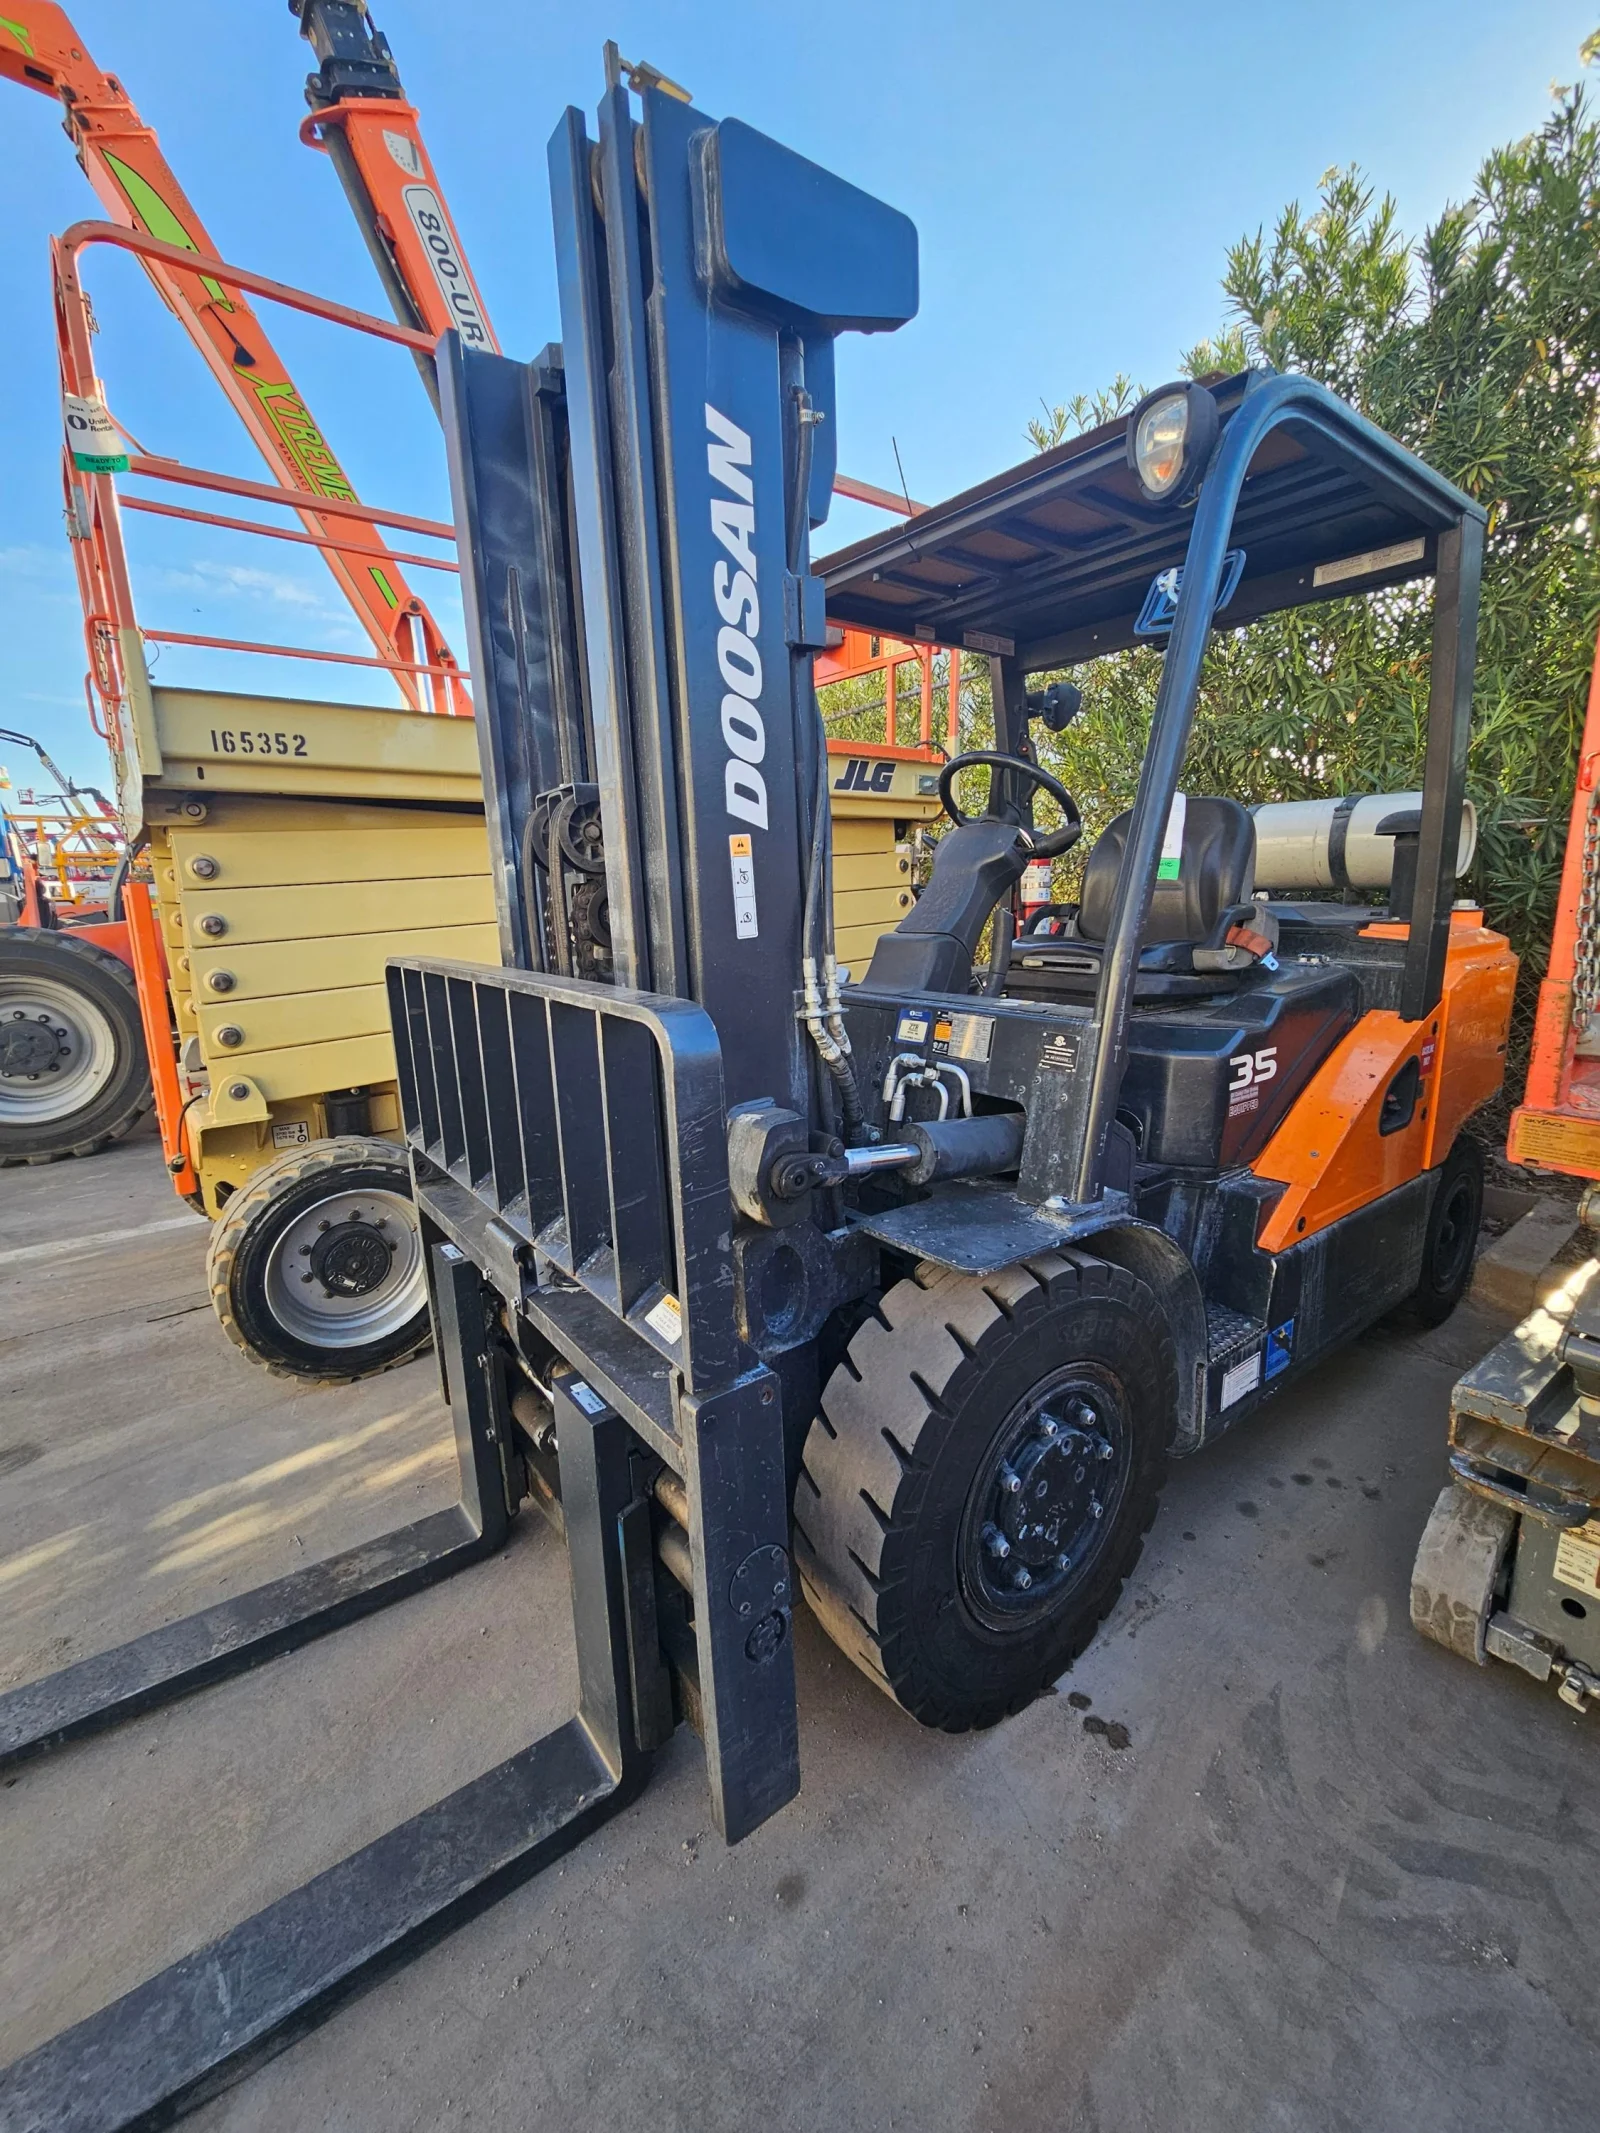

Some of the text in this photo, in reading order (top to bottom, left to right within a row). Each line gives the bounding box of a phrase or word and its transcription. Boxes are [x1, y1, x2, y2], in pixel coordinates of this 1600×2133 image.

[704, 402, 769, 831] DOOSAN
[210, 729, 308, 757] 165352
[833, 759, 897, 793] JLG
[1229, 1046, 1277, 1091] 35
